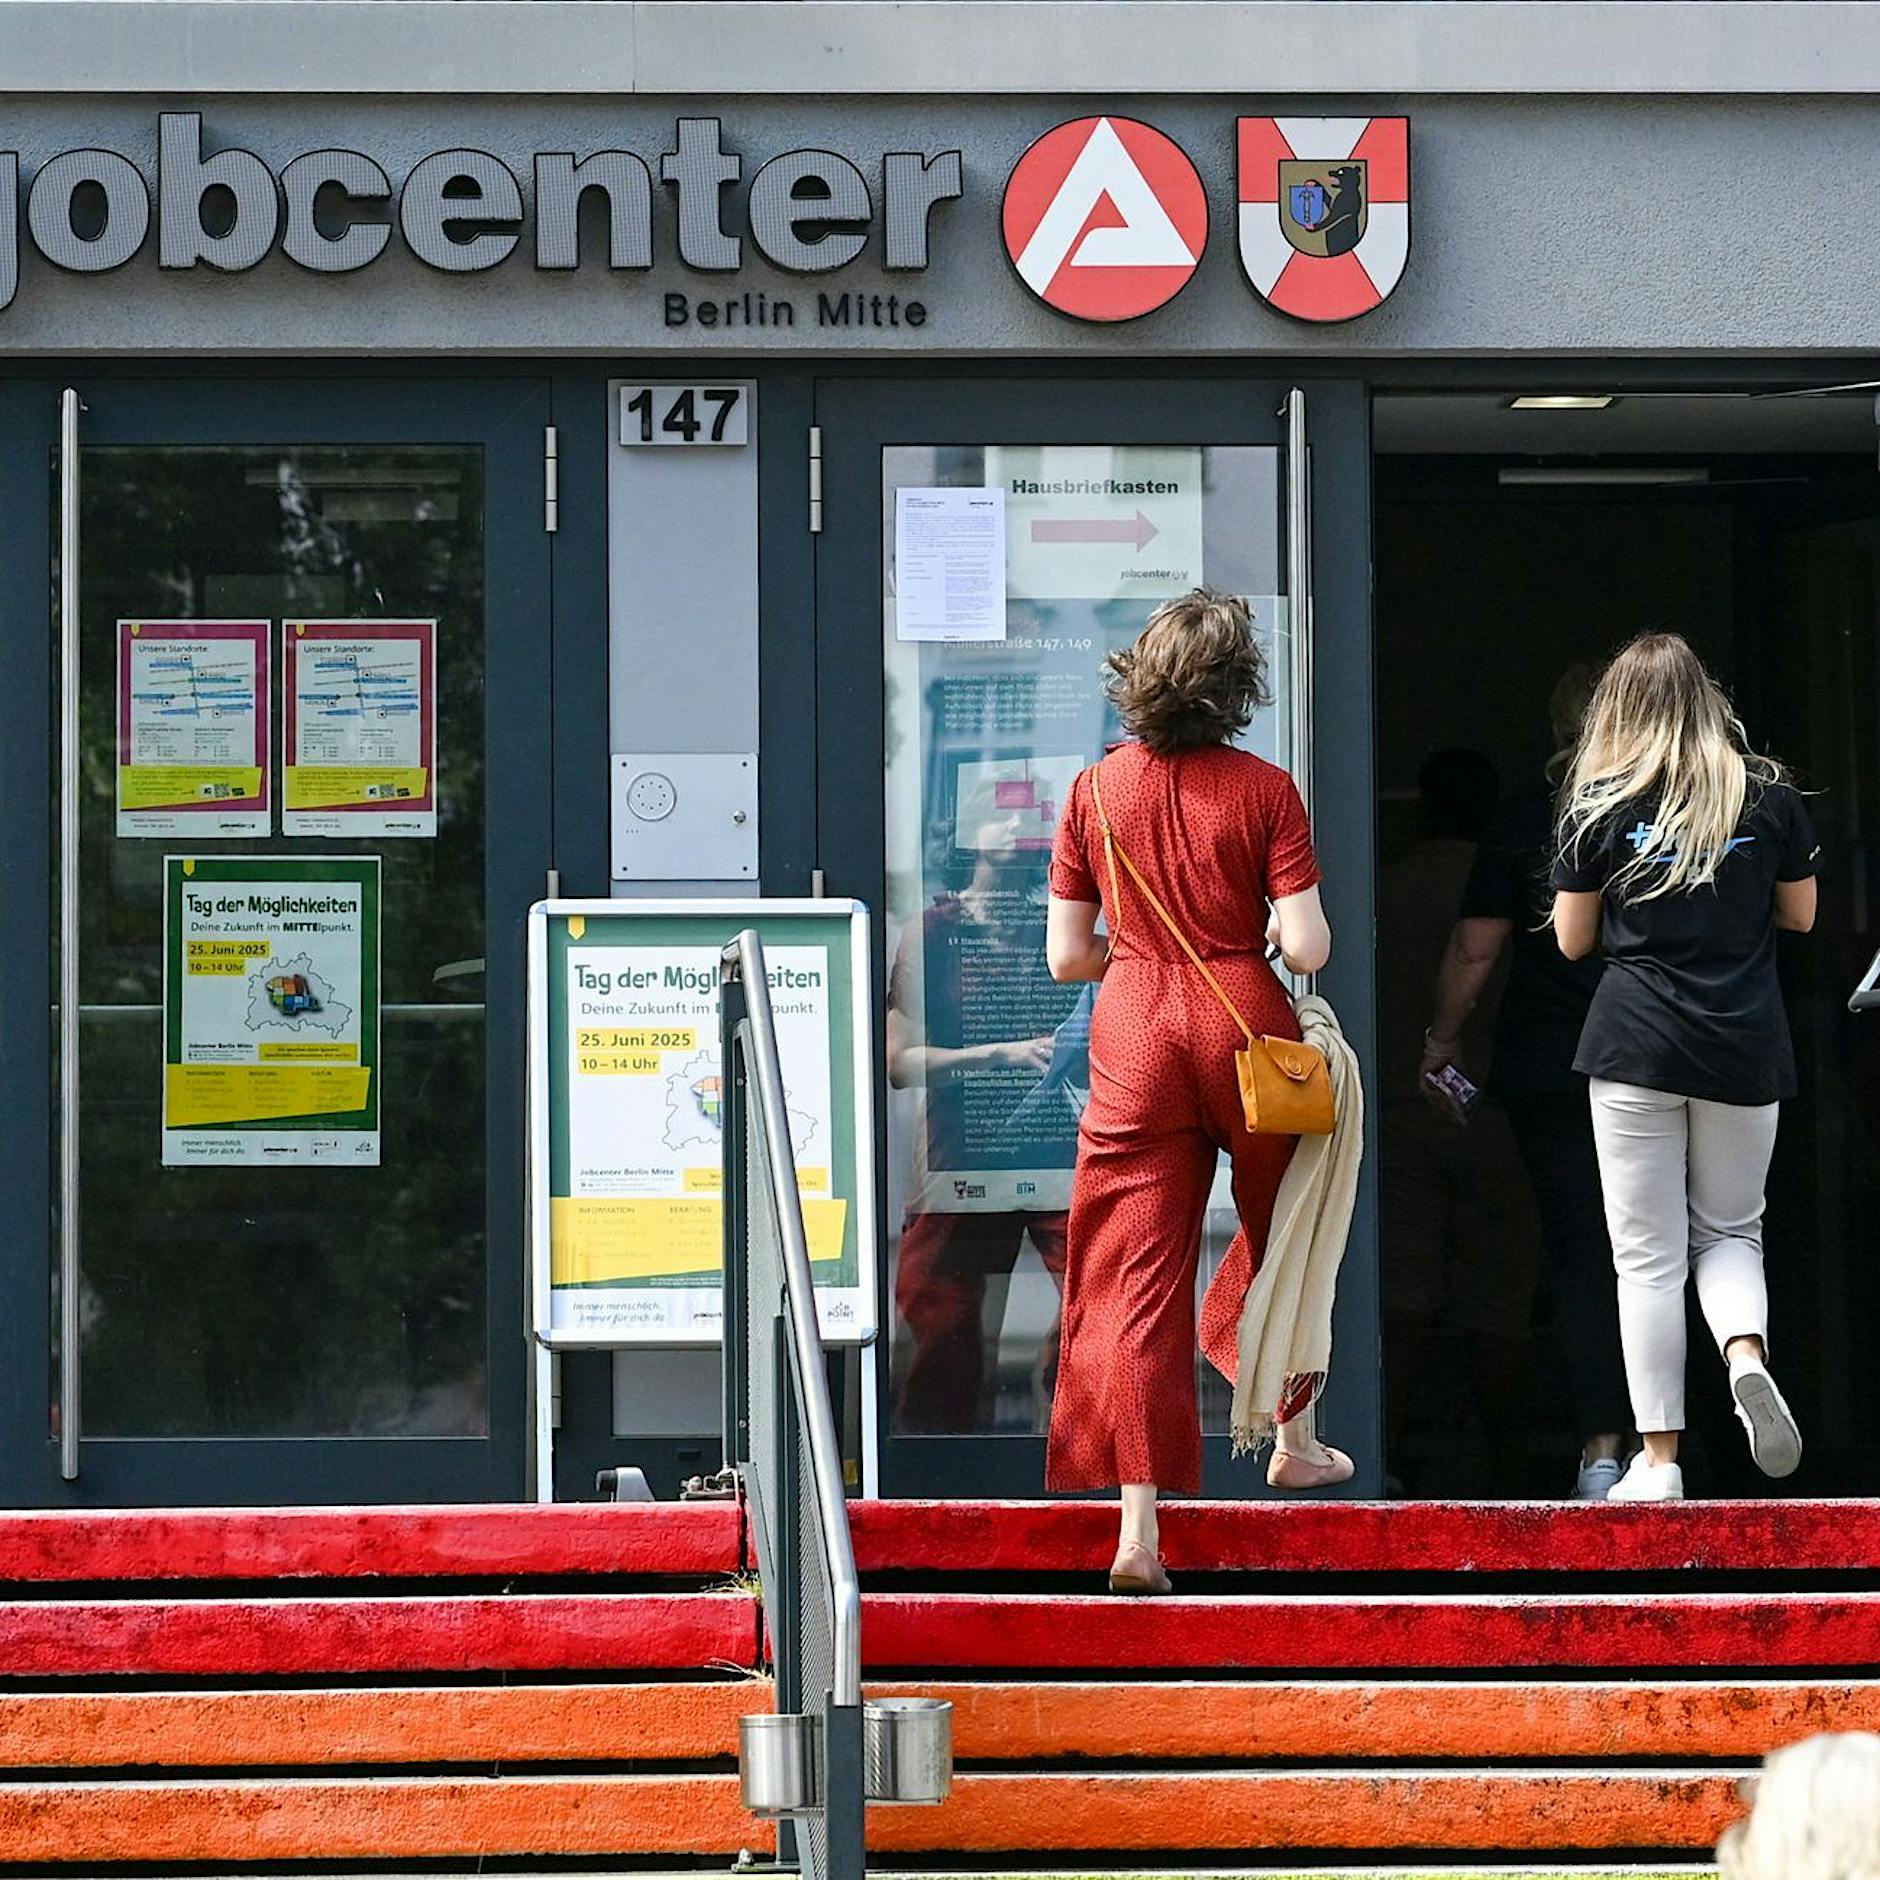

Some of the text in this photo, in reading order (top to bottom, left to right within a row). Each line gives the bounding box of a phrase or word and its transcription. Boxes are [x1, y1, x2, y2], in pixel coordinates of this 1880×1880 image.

[664, 293, 928, 327] Berlin Mitte
[627, 389, 740, 443] 147
[1012, 479, 1179, 494] Hausbriefkasten
[1120, 568, 1171, 580] jobcenter
[187, 894, 357, 917] Tag der Möglichkeiten
[191, 922, 221, 932] Deine
[223, 922, 264, 932] Zukunft
[267, 922, 280, 932] im
[190, 944, 266, 955] 25. Juni 2025
[225, 962, 244, 972] Uhr
[575, 965, 821, 995] Tag der Mögleiten
[582, 1002, 624, 1015] Deine
[629, 1002, 687, 1015] Zukunft
[692, 1002, 710, 1014] im
[581, 1033, 691, 1046] 25. Juni 2025
[632, 1058, 658, 1070] Uhr
[624, 1168, 649, 1176] Berlin
[651, 1168, 674, 1176] Mitte
